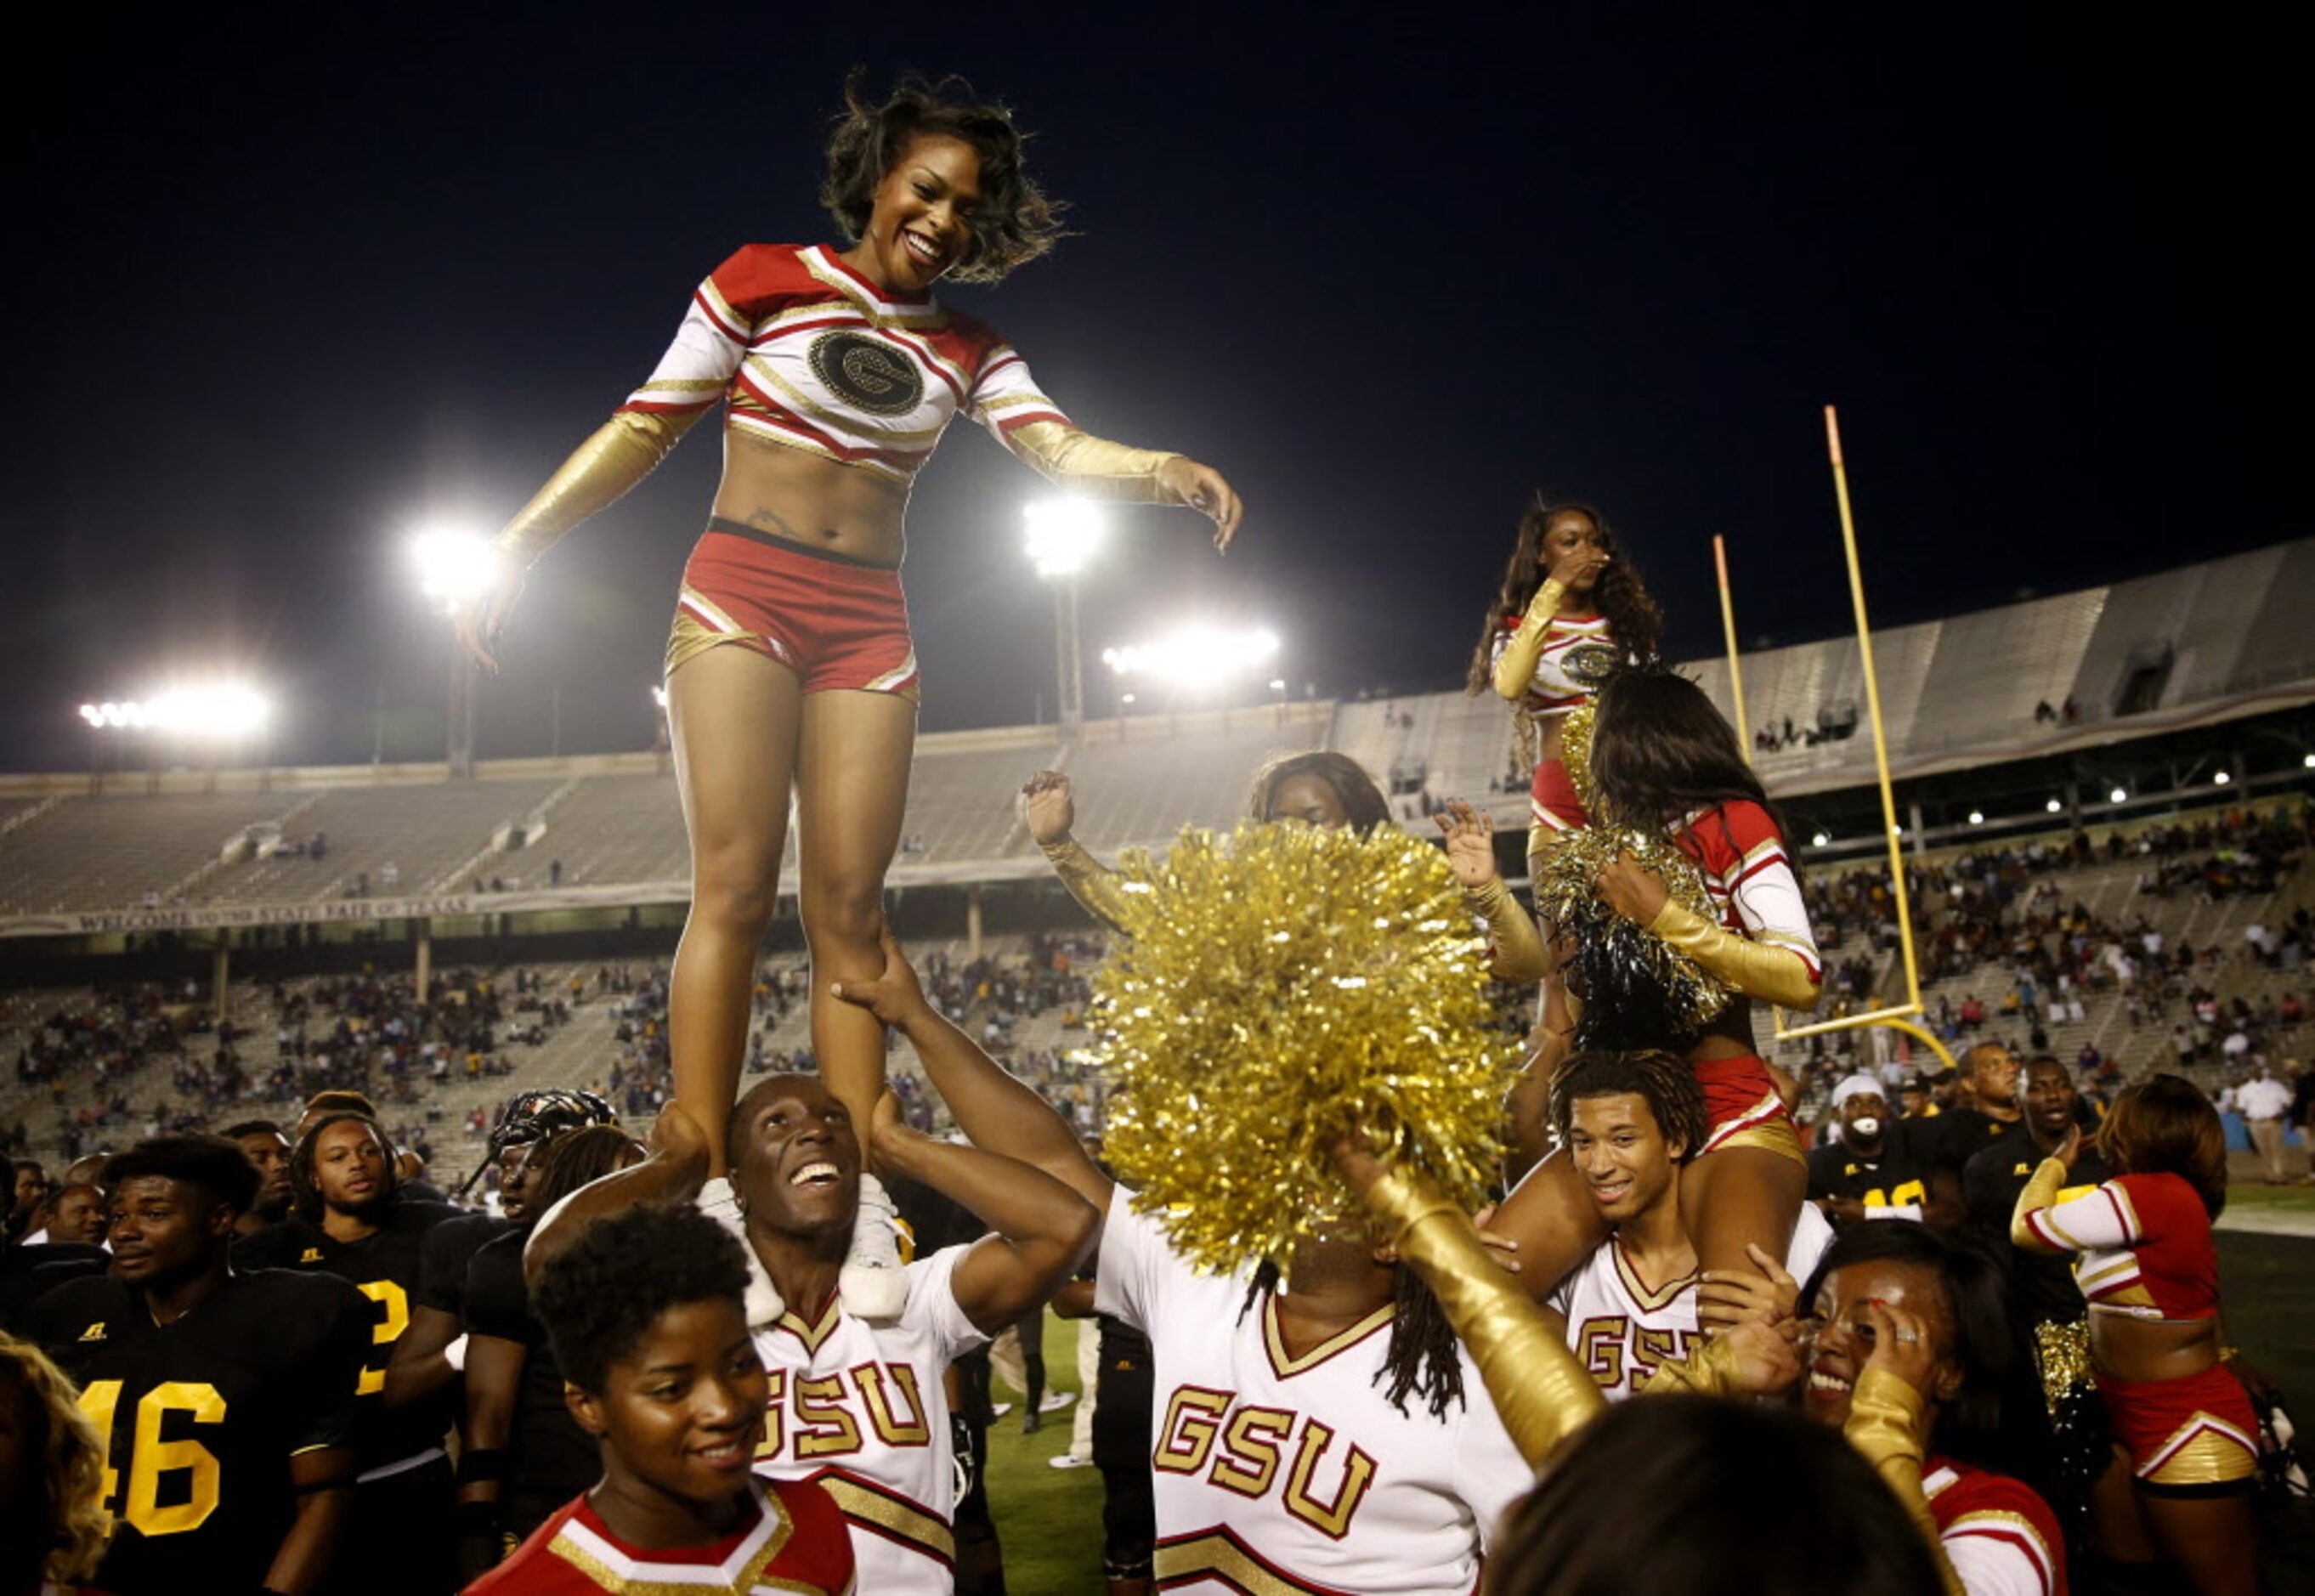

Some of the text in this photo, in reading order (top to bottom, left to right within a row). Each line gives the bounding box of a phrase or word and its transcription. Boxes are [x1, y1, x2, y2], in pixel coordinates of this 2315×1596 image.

[79, 911, 190, 931] WELCOME
[198, 910, 218, 924] TO
[258, 906, 314, 923] STATE
[325, 903, 371, 919] FAIR
[405, 898, 468, 915] TEXAS
[1575, 1316, 1701, 1392] GS
[1152, 1384, 1378, 1542] GSU
